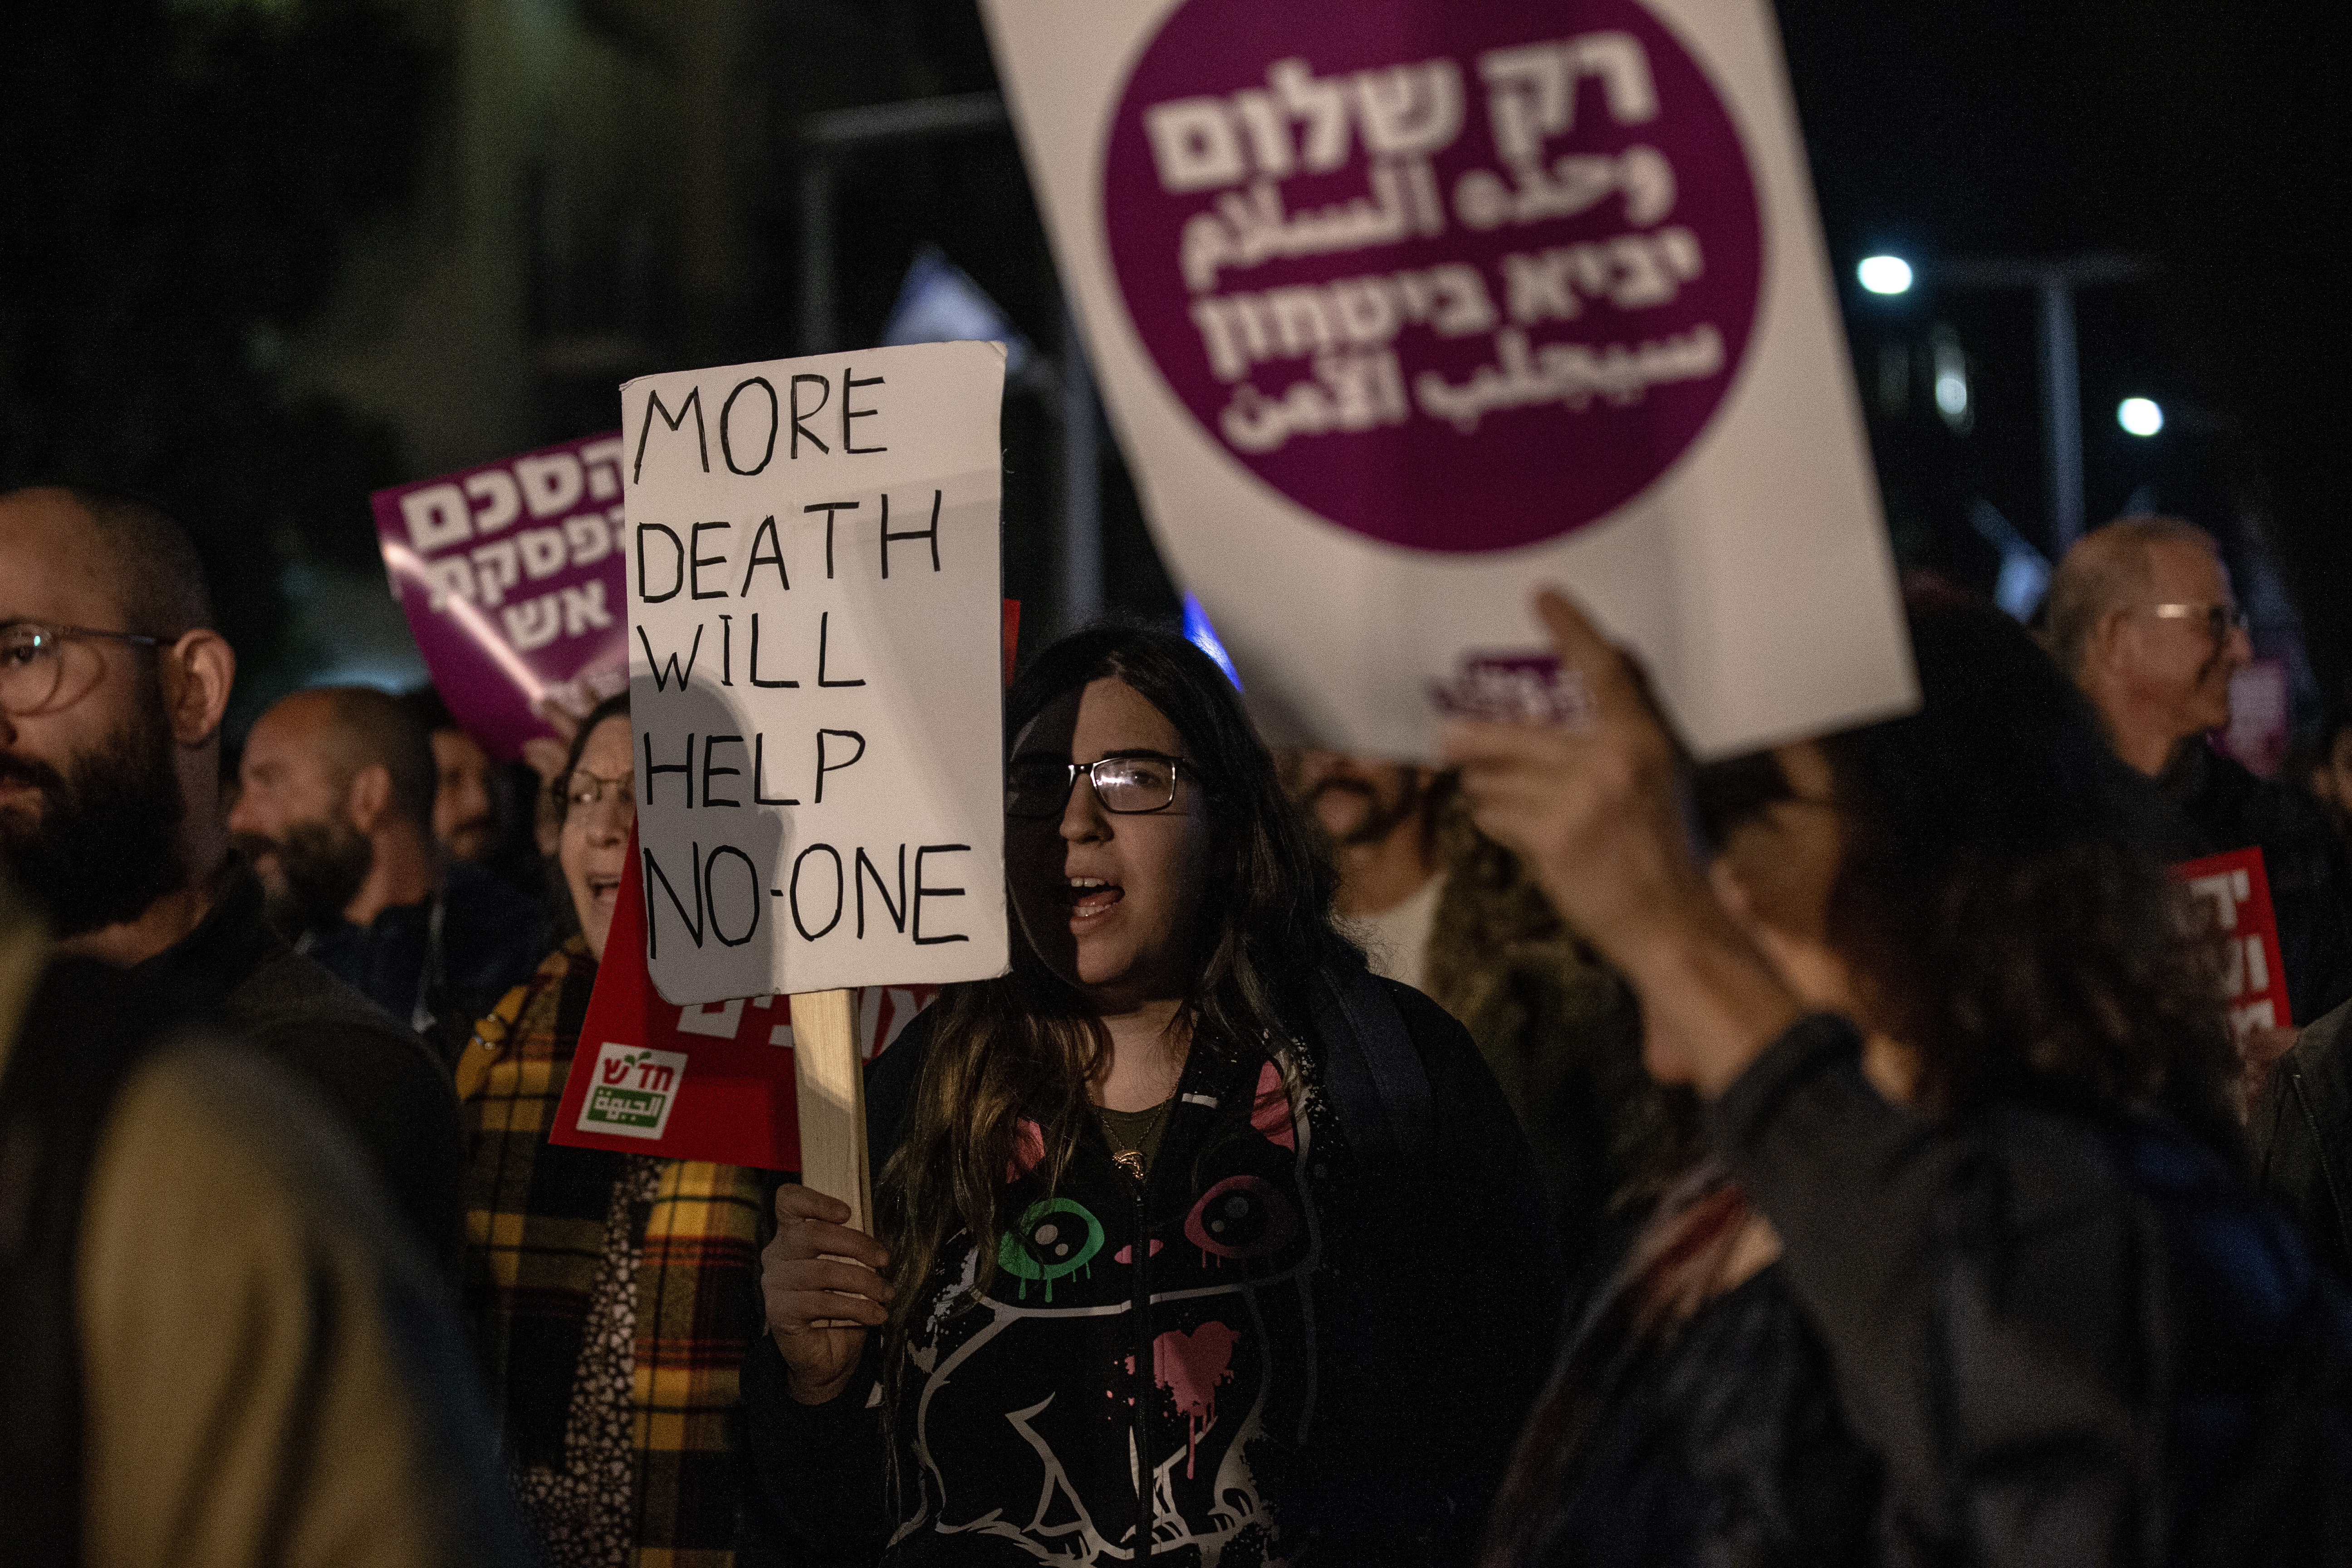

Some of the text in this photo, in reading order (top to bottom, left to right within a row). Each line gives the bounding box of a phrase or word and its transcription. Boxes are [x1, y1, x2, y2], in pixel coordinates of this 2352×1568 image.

[1142, 29, 1660, 194] רק שלום
[1179, 156, 1446, 294] السلام
[1189, 226, 1705, 382] יביא ביטחון
[634, 367, 888, 485] MORE
[1412, 323, 1726, 434] سيجلب
[399, 436, 623, 552] הסכם
[637, 490, 941, 603] DEATH
[502, 578, 614, 651] אש
[636, 611, 866, 693] WILL
[643, 727, 866, 809] HELP
[643, 841, 971, 960] NO-ONE
